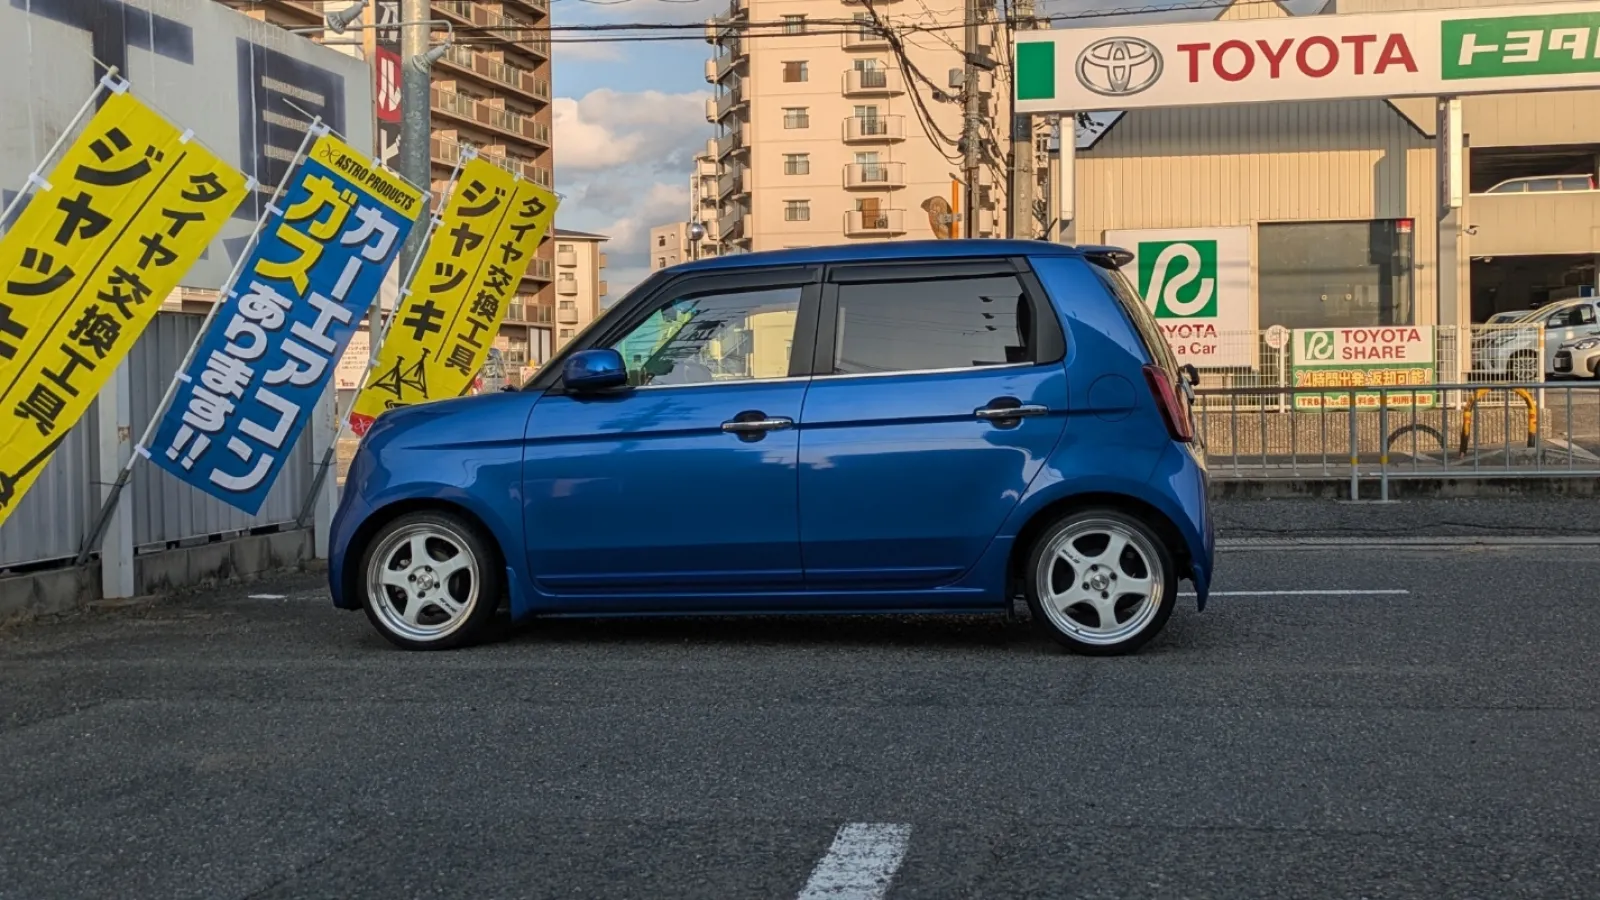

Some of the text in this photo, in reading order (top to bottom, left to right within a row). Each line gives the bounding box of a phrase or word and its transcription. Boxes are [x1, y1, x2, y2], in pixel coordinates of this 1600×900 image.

[1176, 32, 1419, 84] TOYOTA
[335, 154, 416, 211] ASTRO PRODUCTS
[403, 180, 506, 342] ジャッキ
[444, 197, 546, 376] タイヤ交換工具
[13, 171, 228, 437] タイヤ交換工具
[1159, 324, 1218, 338] YOTA
[209, 204, 400, 491] カーエアコン
[1190, 342, 1217, 354] Car
[1341, 328, 1421, 344] TOYOTA
[1342, 345, 1406, 360] SHARE
